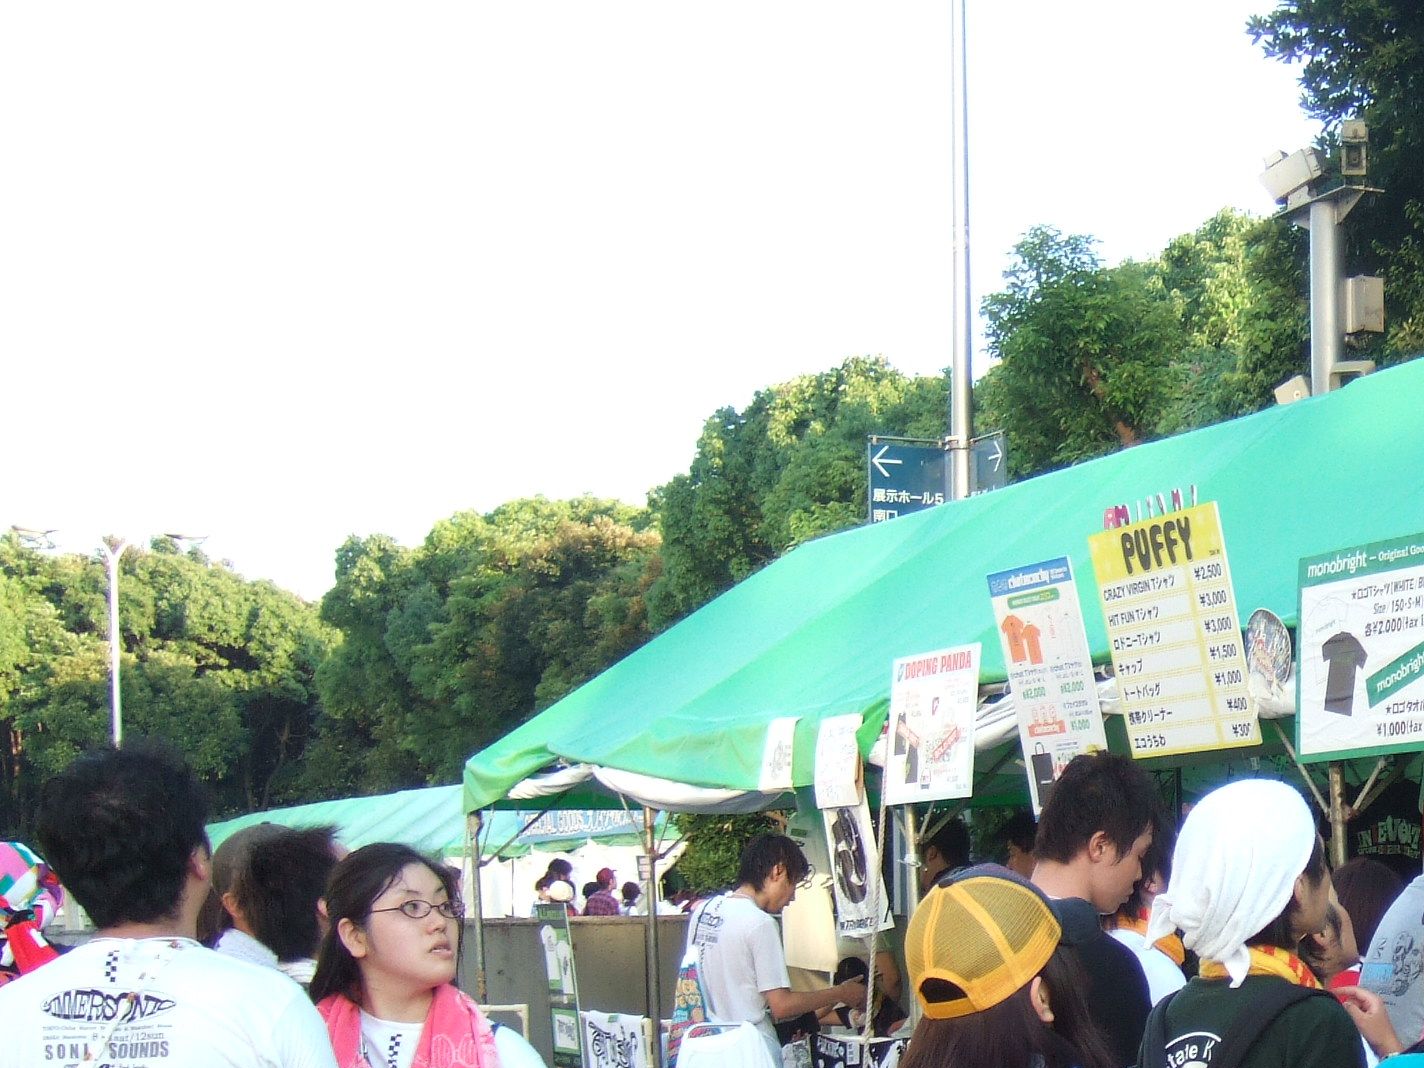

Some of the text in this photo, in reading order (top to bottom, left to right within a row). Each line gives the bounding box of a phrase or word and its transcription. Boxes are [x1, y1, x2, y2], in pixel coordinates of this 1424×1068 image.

[873, 488, 944, 504] 展示ホール5
[1121, 516, 1193, 576] PUFFY
[1307, 551, 1367, 577] monobright
[1378, 546, 1409, 561] Original
[1194, 563, 1222, 581] ¥2,500
[1104, 583, 1126, 601] CRAZY
[1126, 578, 1150, 595] VIRGIN
[1199, 590, 1227, 607] ¥3,000
[1109, 611, 1121, 627] HIT
[1121, 609, 1135, 625] FUN
[1204, 616, 1232, 634] ¥3,000
[1210, 643, 1237, 661] ¥1,500
[904, 651, 972, 680] DOPING PANDA
[1118, 659, 1143, 675] キャップ
[1215, 670, 1242, 687] ¥1,000
[1227, 698, 1248, 712] ¥400
[108, 1041, 169, 1060] SOUNDS
